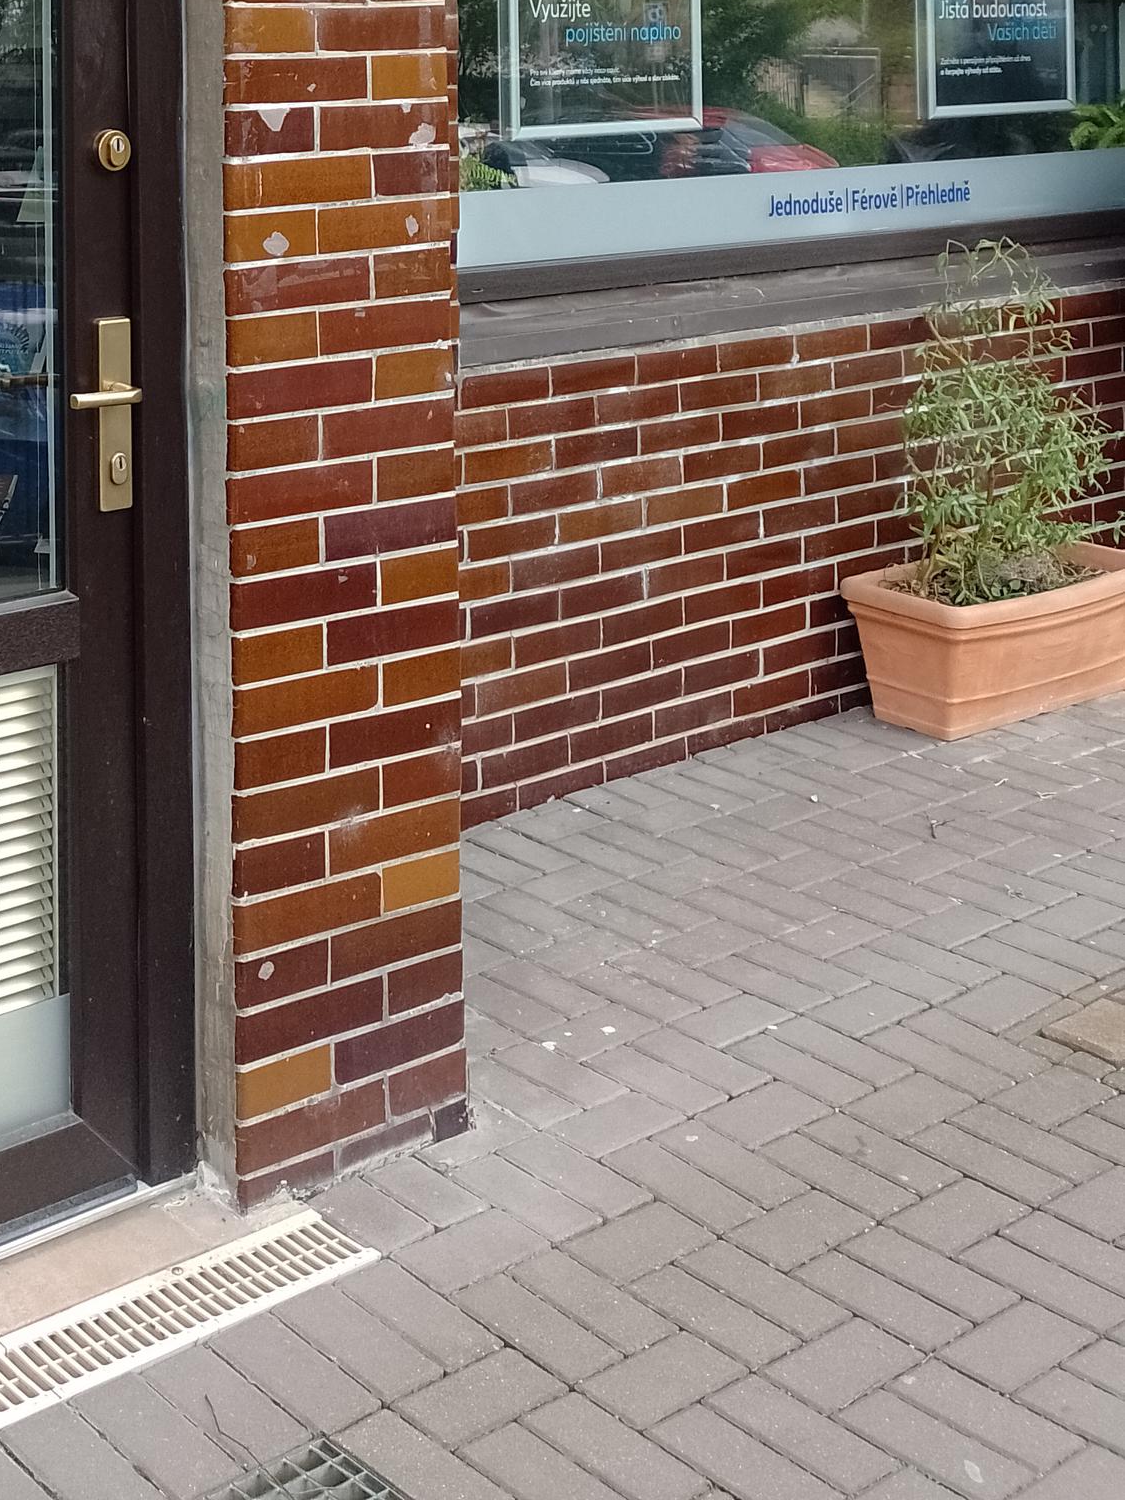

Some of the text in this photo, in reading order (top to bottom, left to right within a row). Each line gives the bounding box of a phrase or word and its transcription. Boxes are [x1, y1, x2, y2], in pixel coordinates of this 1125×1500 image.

[938, 0, 969, 19] Jistá
[565, 21, 682, 47] pojištění naplno
[987, 21, 1029, 41] Vašich
[768, 180, 971, 218] Jednoduše Férově Přehledně
